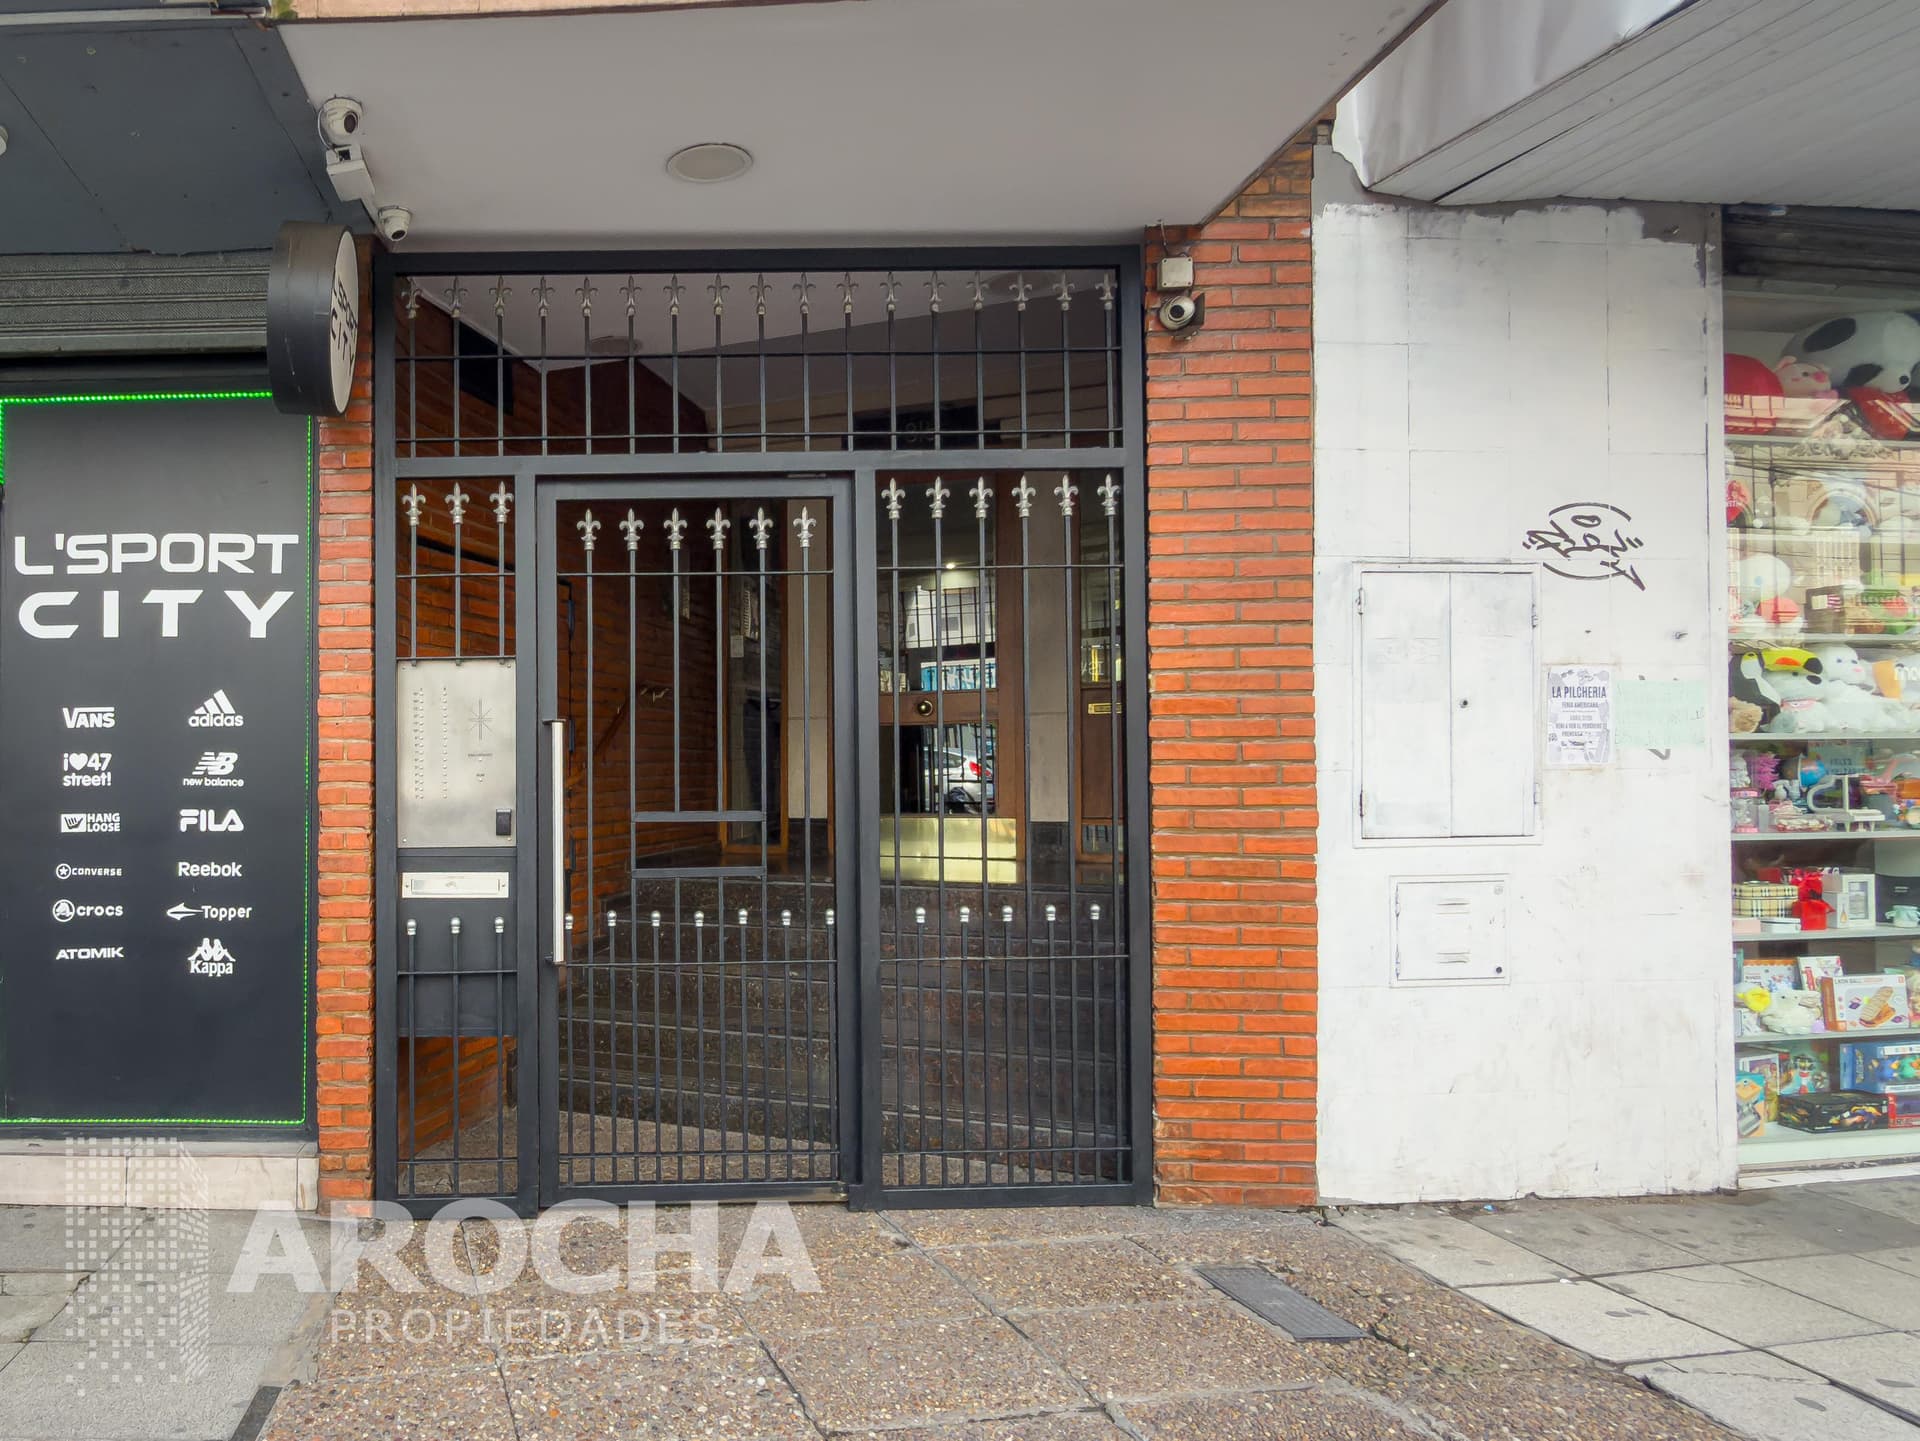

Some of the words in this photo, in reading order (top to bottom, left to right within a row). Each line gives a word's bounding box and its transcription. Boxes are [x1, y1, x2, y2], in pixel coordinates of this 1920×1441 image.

[13, 533, 300, 576] L'SPORT
[18, 588, 296, 640] CITY
[1551, 686, 1562, 698] LA
[1564, 686, 1607, 698] PILCHERIA
[62, 706, 115, 729] VANS
[188, 713, 244, 727] adidas
[62, 771, 112, 787] street!
[183, 778, 203, 787] new
[204, 777, 245, 787] balance
[87, 812, 121, 823] HANG
[180, 808, 245, 832] FILA
[87, 822, 121, 833] LOOSE
[178, 861, 243, 877] Reebok
[76, 905, 124, 917] crocs
[201, 905, 253, 922] Topper
[55, 946, 125, 960] ATOMIK
[189, 960, 234, 977] Kappa
